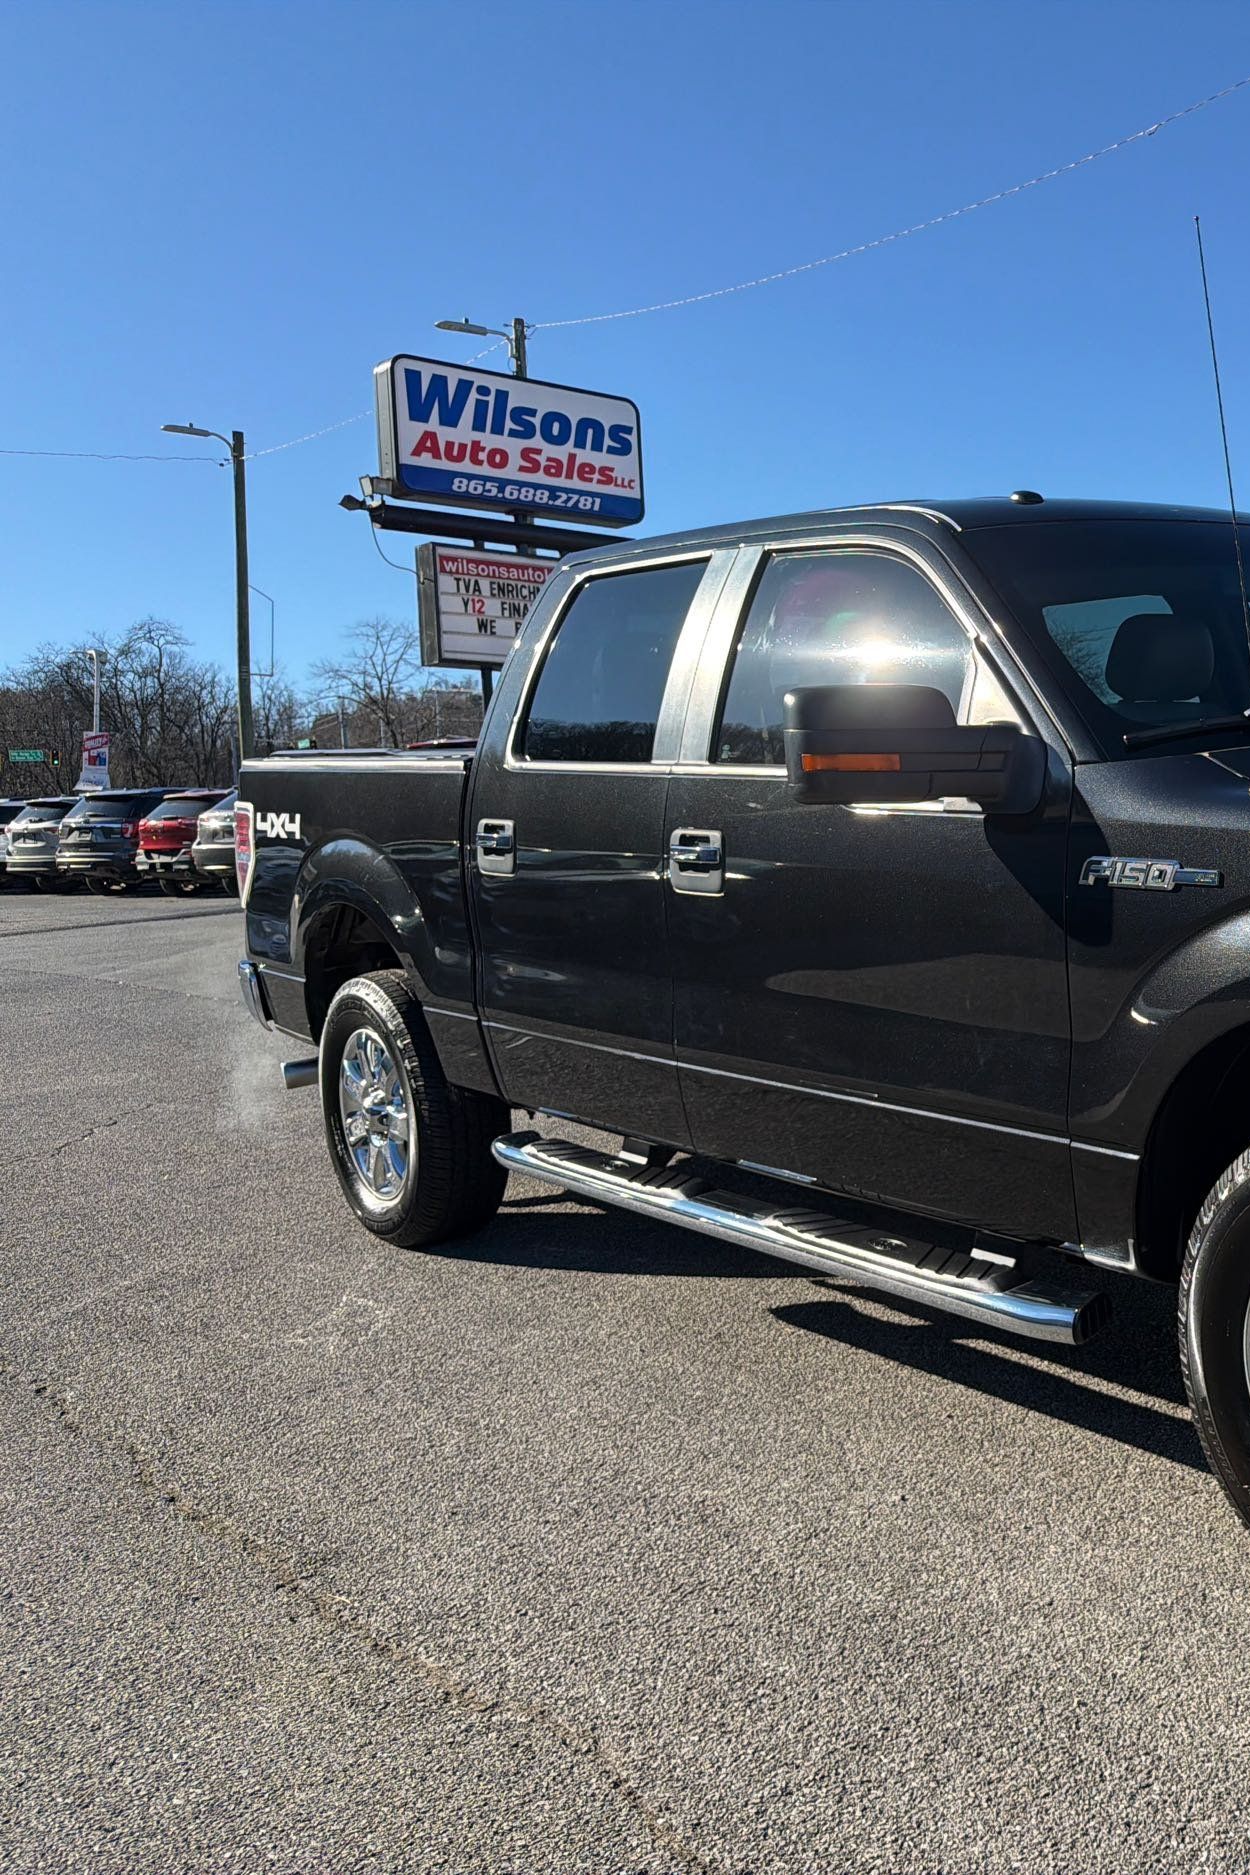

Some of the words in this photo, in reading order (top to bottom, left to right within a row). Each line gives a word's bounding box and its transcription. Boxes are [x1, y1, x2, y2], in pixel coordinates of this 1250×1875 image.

[404, 368, 634, 457] Wilsons
[410, 430, 509, 470] Auto
[518, 447, 615, 486] Sales
[613, 476, 636, 490] LLC
[452, 477, 602, 512] 865.688.2781
[454, 577, 482, 595] TVA
[462, 597, 485, 614] Y12
[501, 601, 532, 618] FINA
[477, 618, 497, 635] WE
